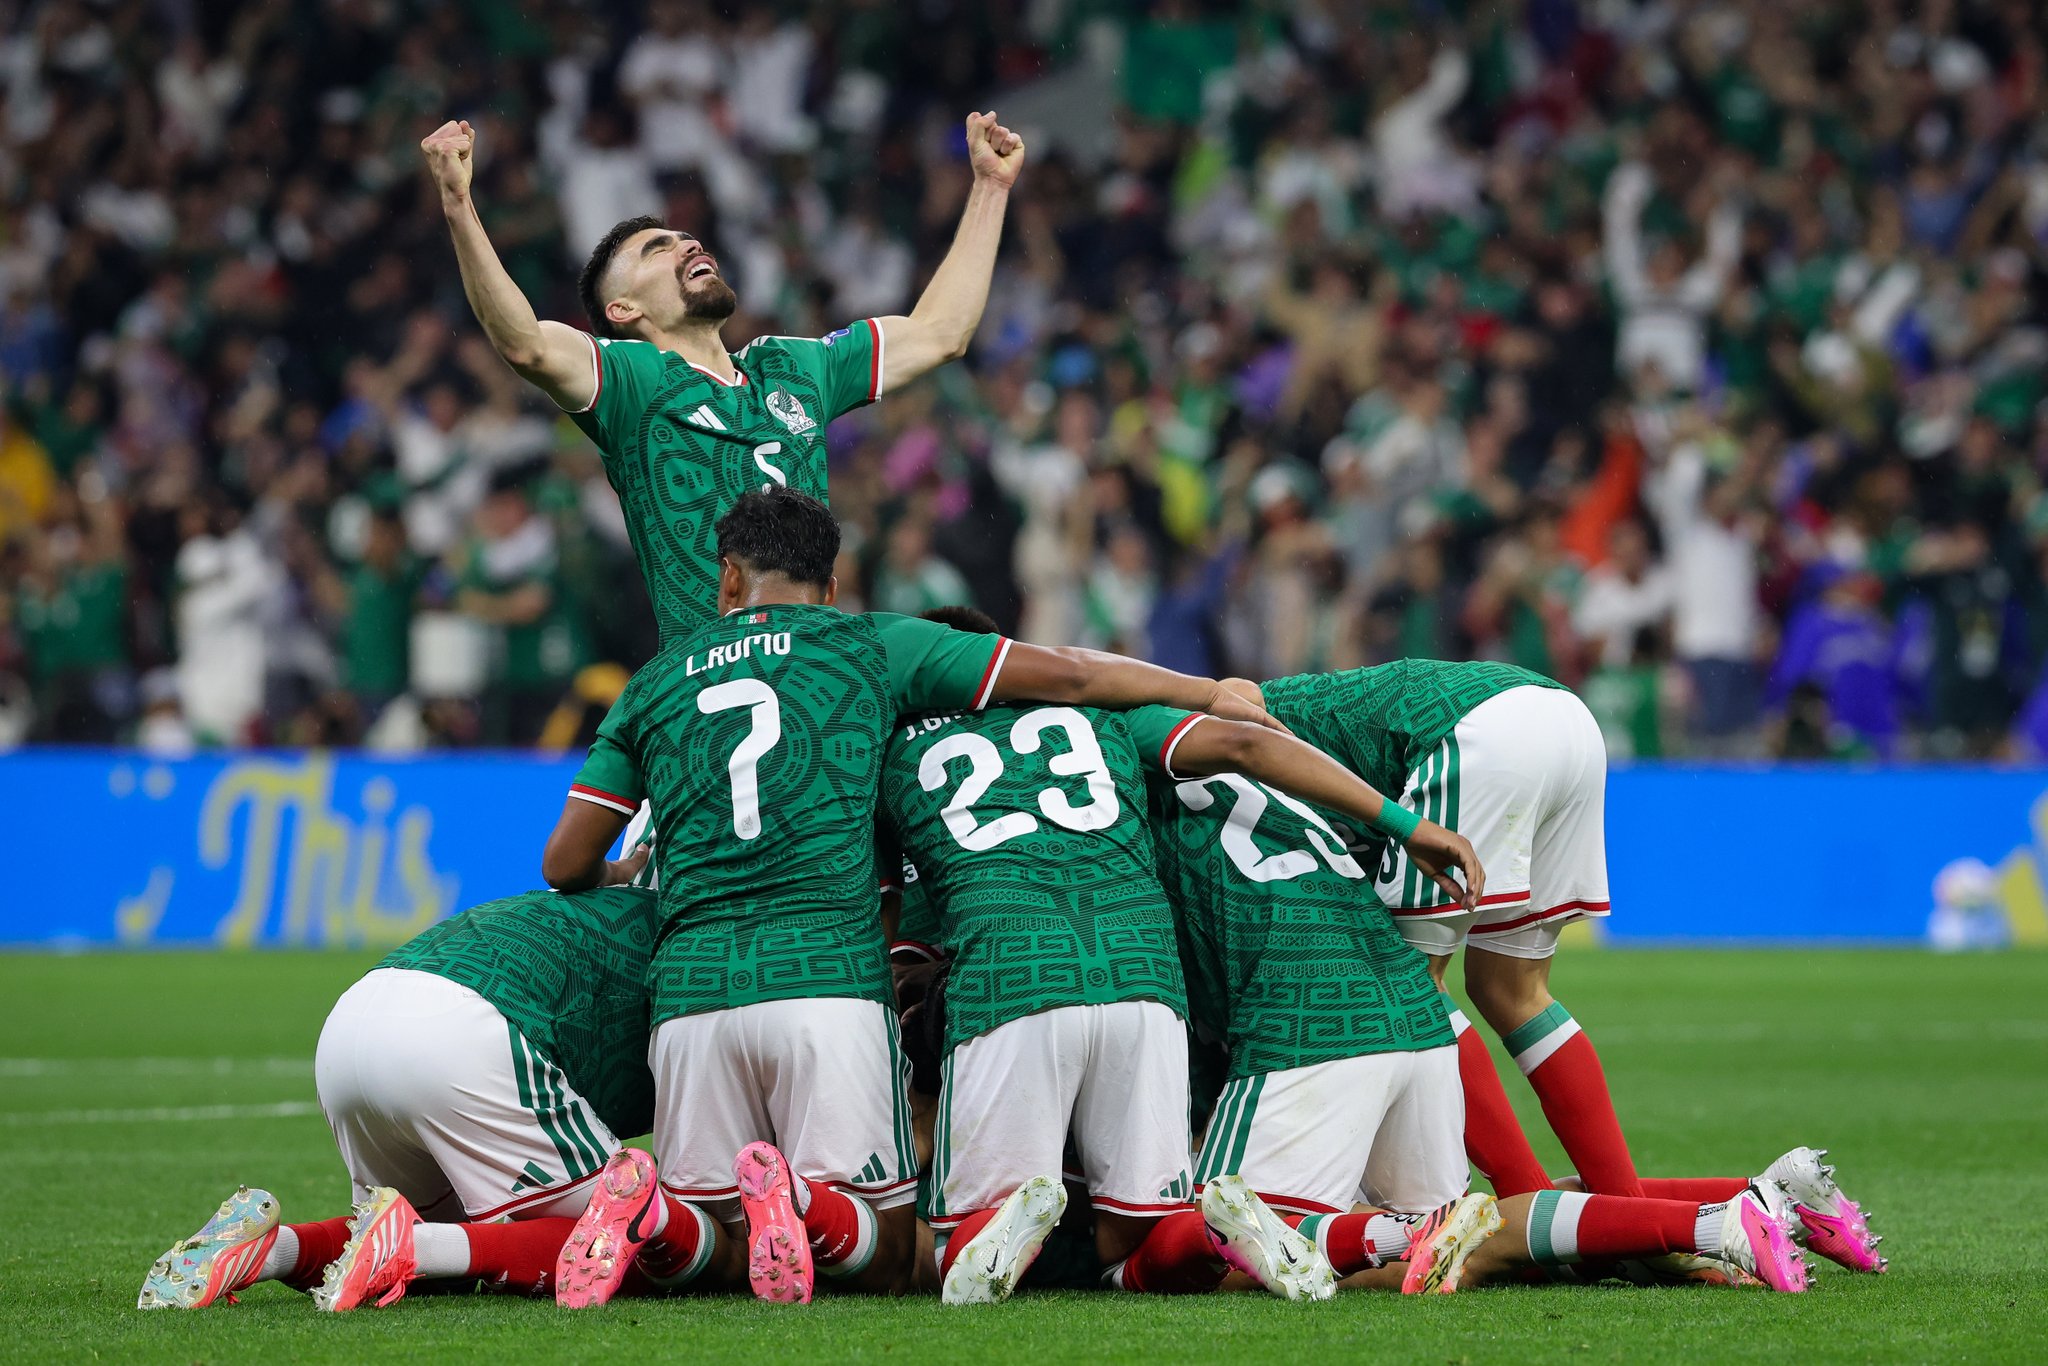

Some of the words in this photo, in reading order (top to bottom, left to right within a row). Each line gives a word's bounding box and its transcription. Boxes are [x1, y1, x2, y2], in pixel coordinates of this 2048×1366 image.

[754, 441, 787, 494] 5
[790, 419, 815, 433] MEXICO
[686, 632, 791, 676] L.ROMO
[697, 678, 781, 840] 7
[918, 707, 1120, 851] 23
[199, 747, 459, 948] This
